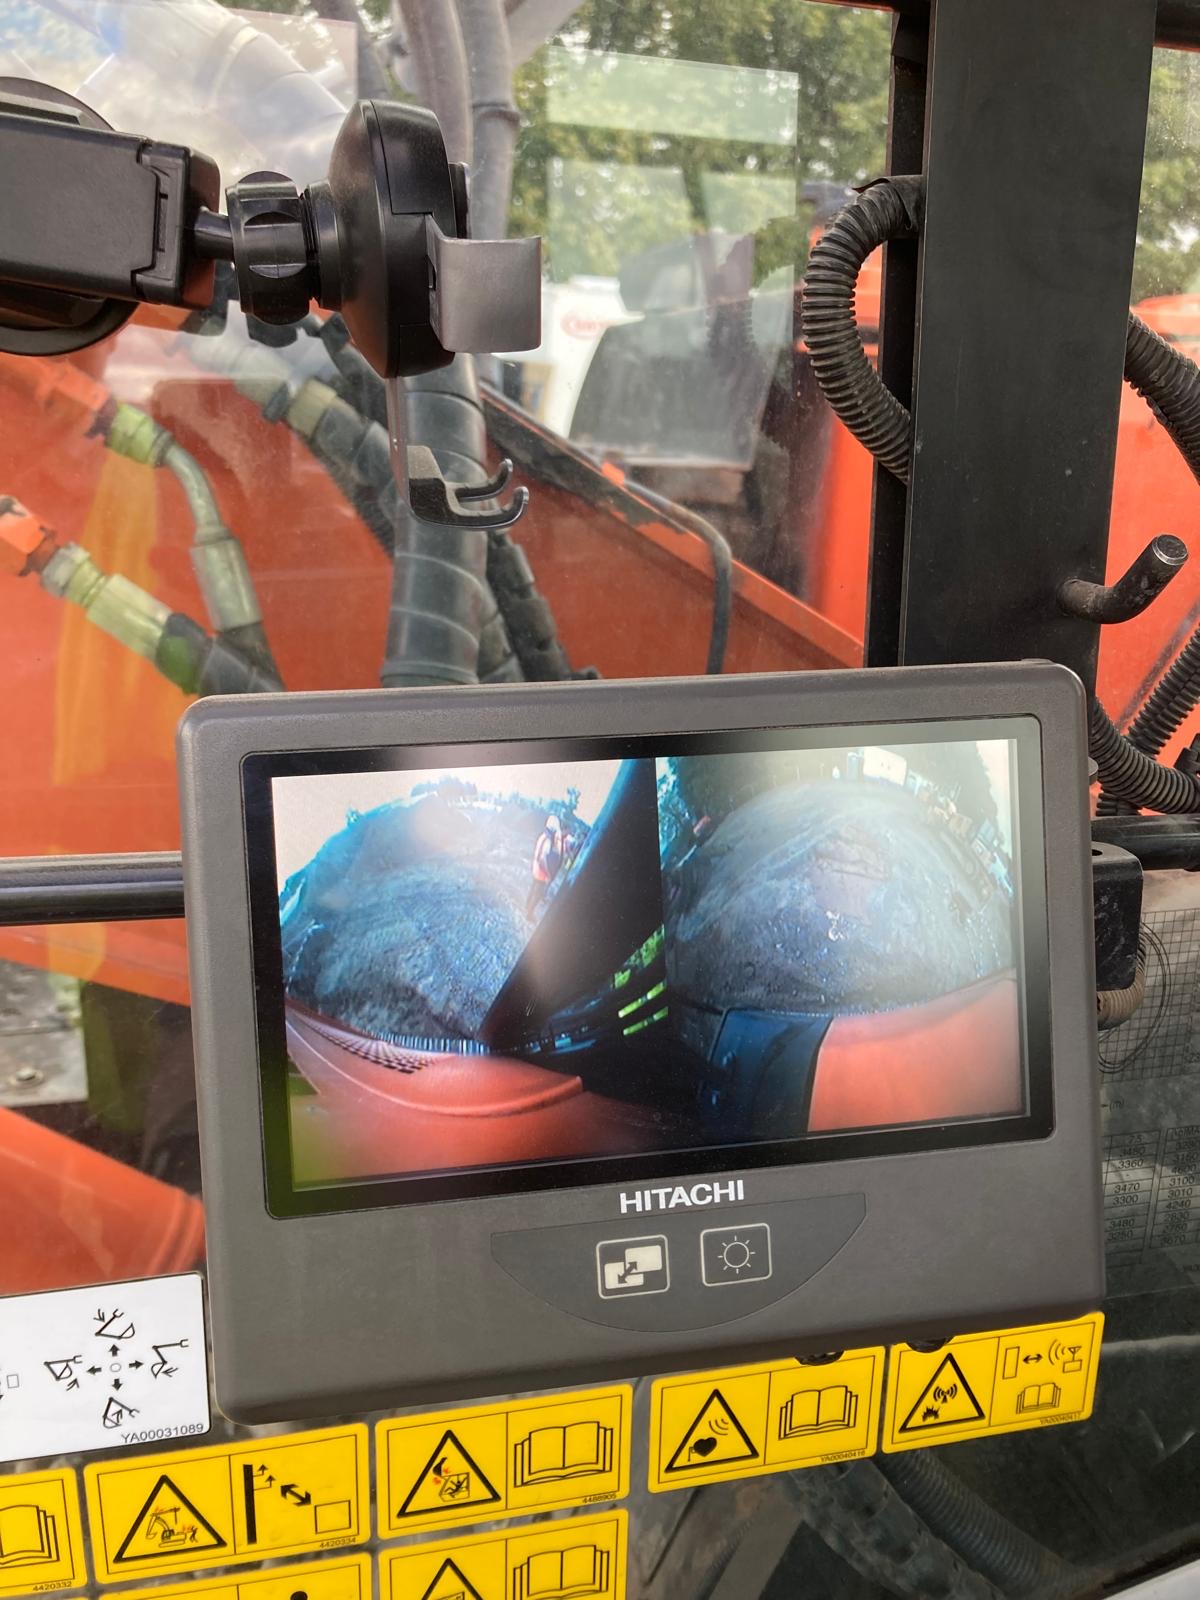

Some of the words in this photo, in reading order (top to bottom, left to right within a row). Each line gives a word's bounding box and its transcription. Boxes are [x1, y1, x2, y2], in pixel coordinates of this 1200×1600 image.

[1118, 1159, 1144, 1169] 3360
[1169, 1176, 1195, 1187] 3100
[1114, 1182, 1140, 1194] 3470
[1168, 1187, 1192, 1198] 3010
[619, 1179, 745, 1214] HITACHI
[1113, 1194, 1138, 1205] 3300
[1166, 1199, 1191, 1209] 4240
[121, 1423, 204, 1443] YA00031089
